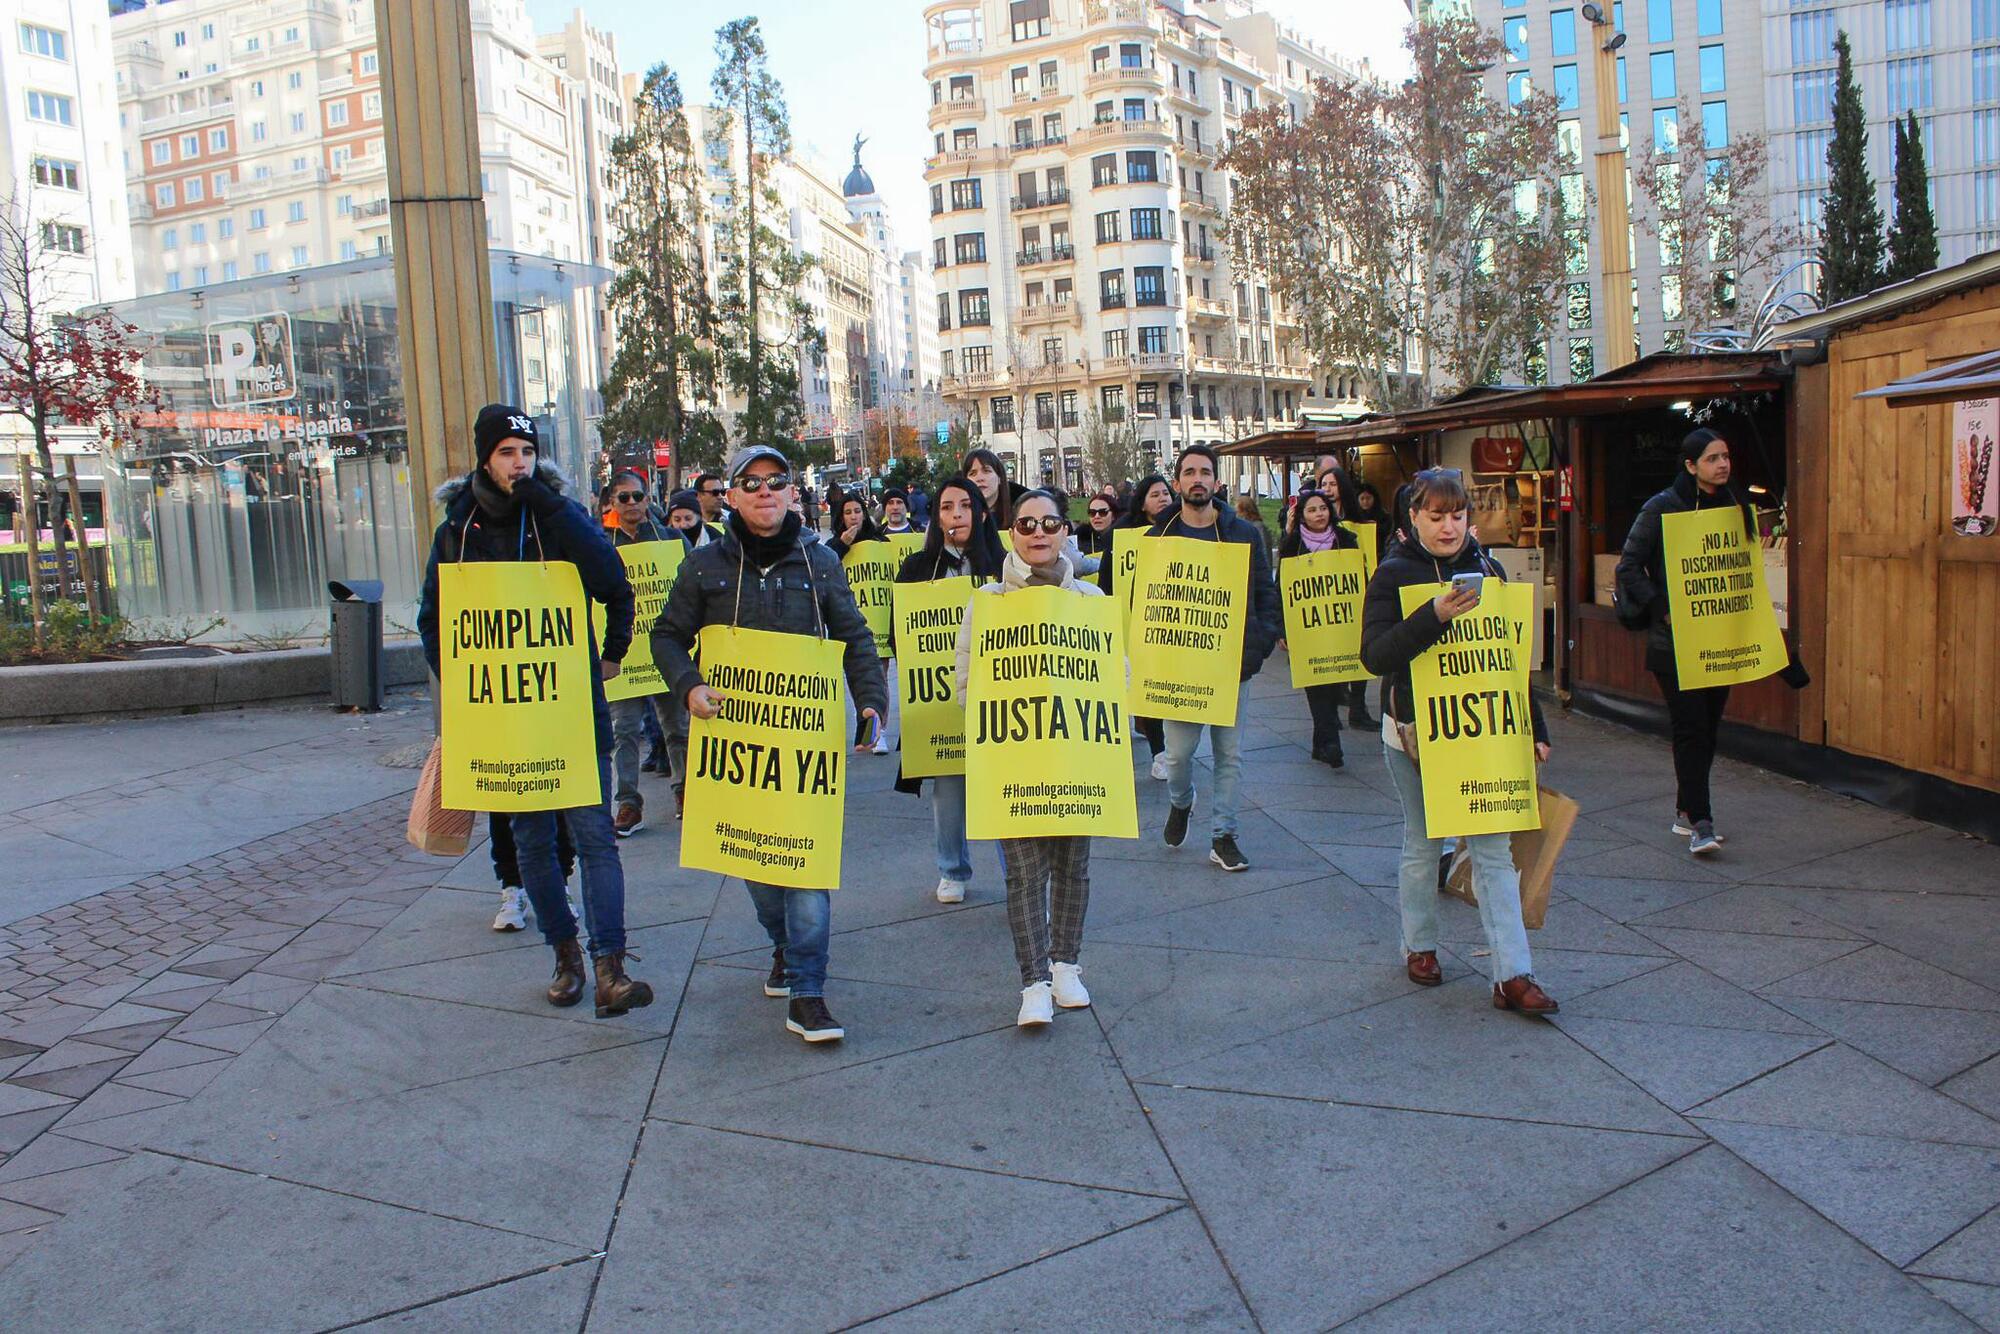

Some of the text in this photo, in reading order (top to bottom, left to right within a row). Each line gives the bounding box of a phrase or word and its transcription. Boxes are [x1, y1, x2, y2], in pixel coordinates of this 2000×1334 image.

[219, 328, 256, 397] P
[268, 363, 283, 378] 24
[256, 379, 286, 393] horas
[205, 414, 352, 447] Plaza de España
[508, 416, 533, 433] NY
[1702, 531, 1739, 555] ¡NO A LA
[638, 564, 645, 578] A
[646, 562, 658, 576] LA
[1165, 562, 1210, 583] ¡NO A LA
[1681, 550, 1752, 575] DISCRIMINACIÓN
[1147, 583, 1231, 608] DISCRIMINACIÓN
[1288, 573, 1359, 607] ¡CUMPLAN
[1684, 577, 1727, 596] CONTRA
[906, 606, 966, 634] ¡HOMOLO
[1144, 605, 1229, 630] CONTRA TÍTULOS
[1302, 602, 1354, 629] LA LEY!
[453, 607, 574, 658] ¡CUMPLAN
[980, 622, 1101, 658] ¡HOMOLOGACIÓN
[1104, 633, 1113, 654] Y
[1514, 622, 1523, 644] Y
[992, 654, 1100, 682] EQUIVALENCIA
[469, 661, 558, 704] LA LEY!
[707, 663, 837, 701] ¡HOMOLOGACIÓN Y
[908, 665, 955, 704] JUS
[1143, 678, 1214, 697] #Homologacionjusta
[1145, 693, 1208, 709] #Homologacionya
[717, 698, 825, 732] EQUIVALENCIA
[976, 695, 1122, 745] JUSTA YA!
[1428, 690, 1517, 743] JUSTA
[470, 757, 566, 777] #Homologacionjusta
[696, 736, 839, 795] JUSTA YA!
[476, 775, 561, 796] #Homologacionya
[1002, 780, 1106, 803] #Homologacionjusta
[1010, 801, 1102, 819] #Homologacionya
[715, 821, 814, 851] #Homologacionjusta
[720, 841, 806, 870] #Homologacionya
